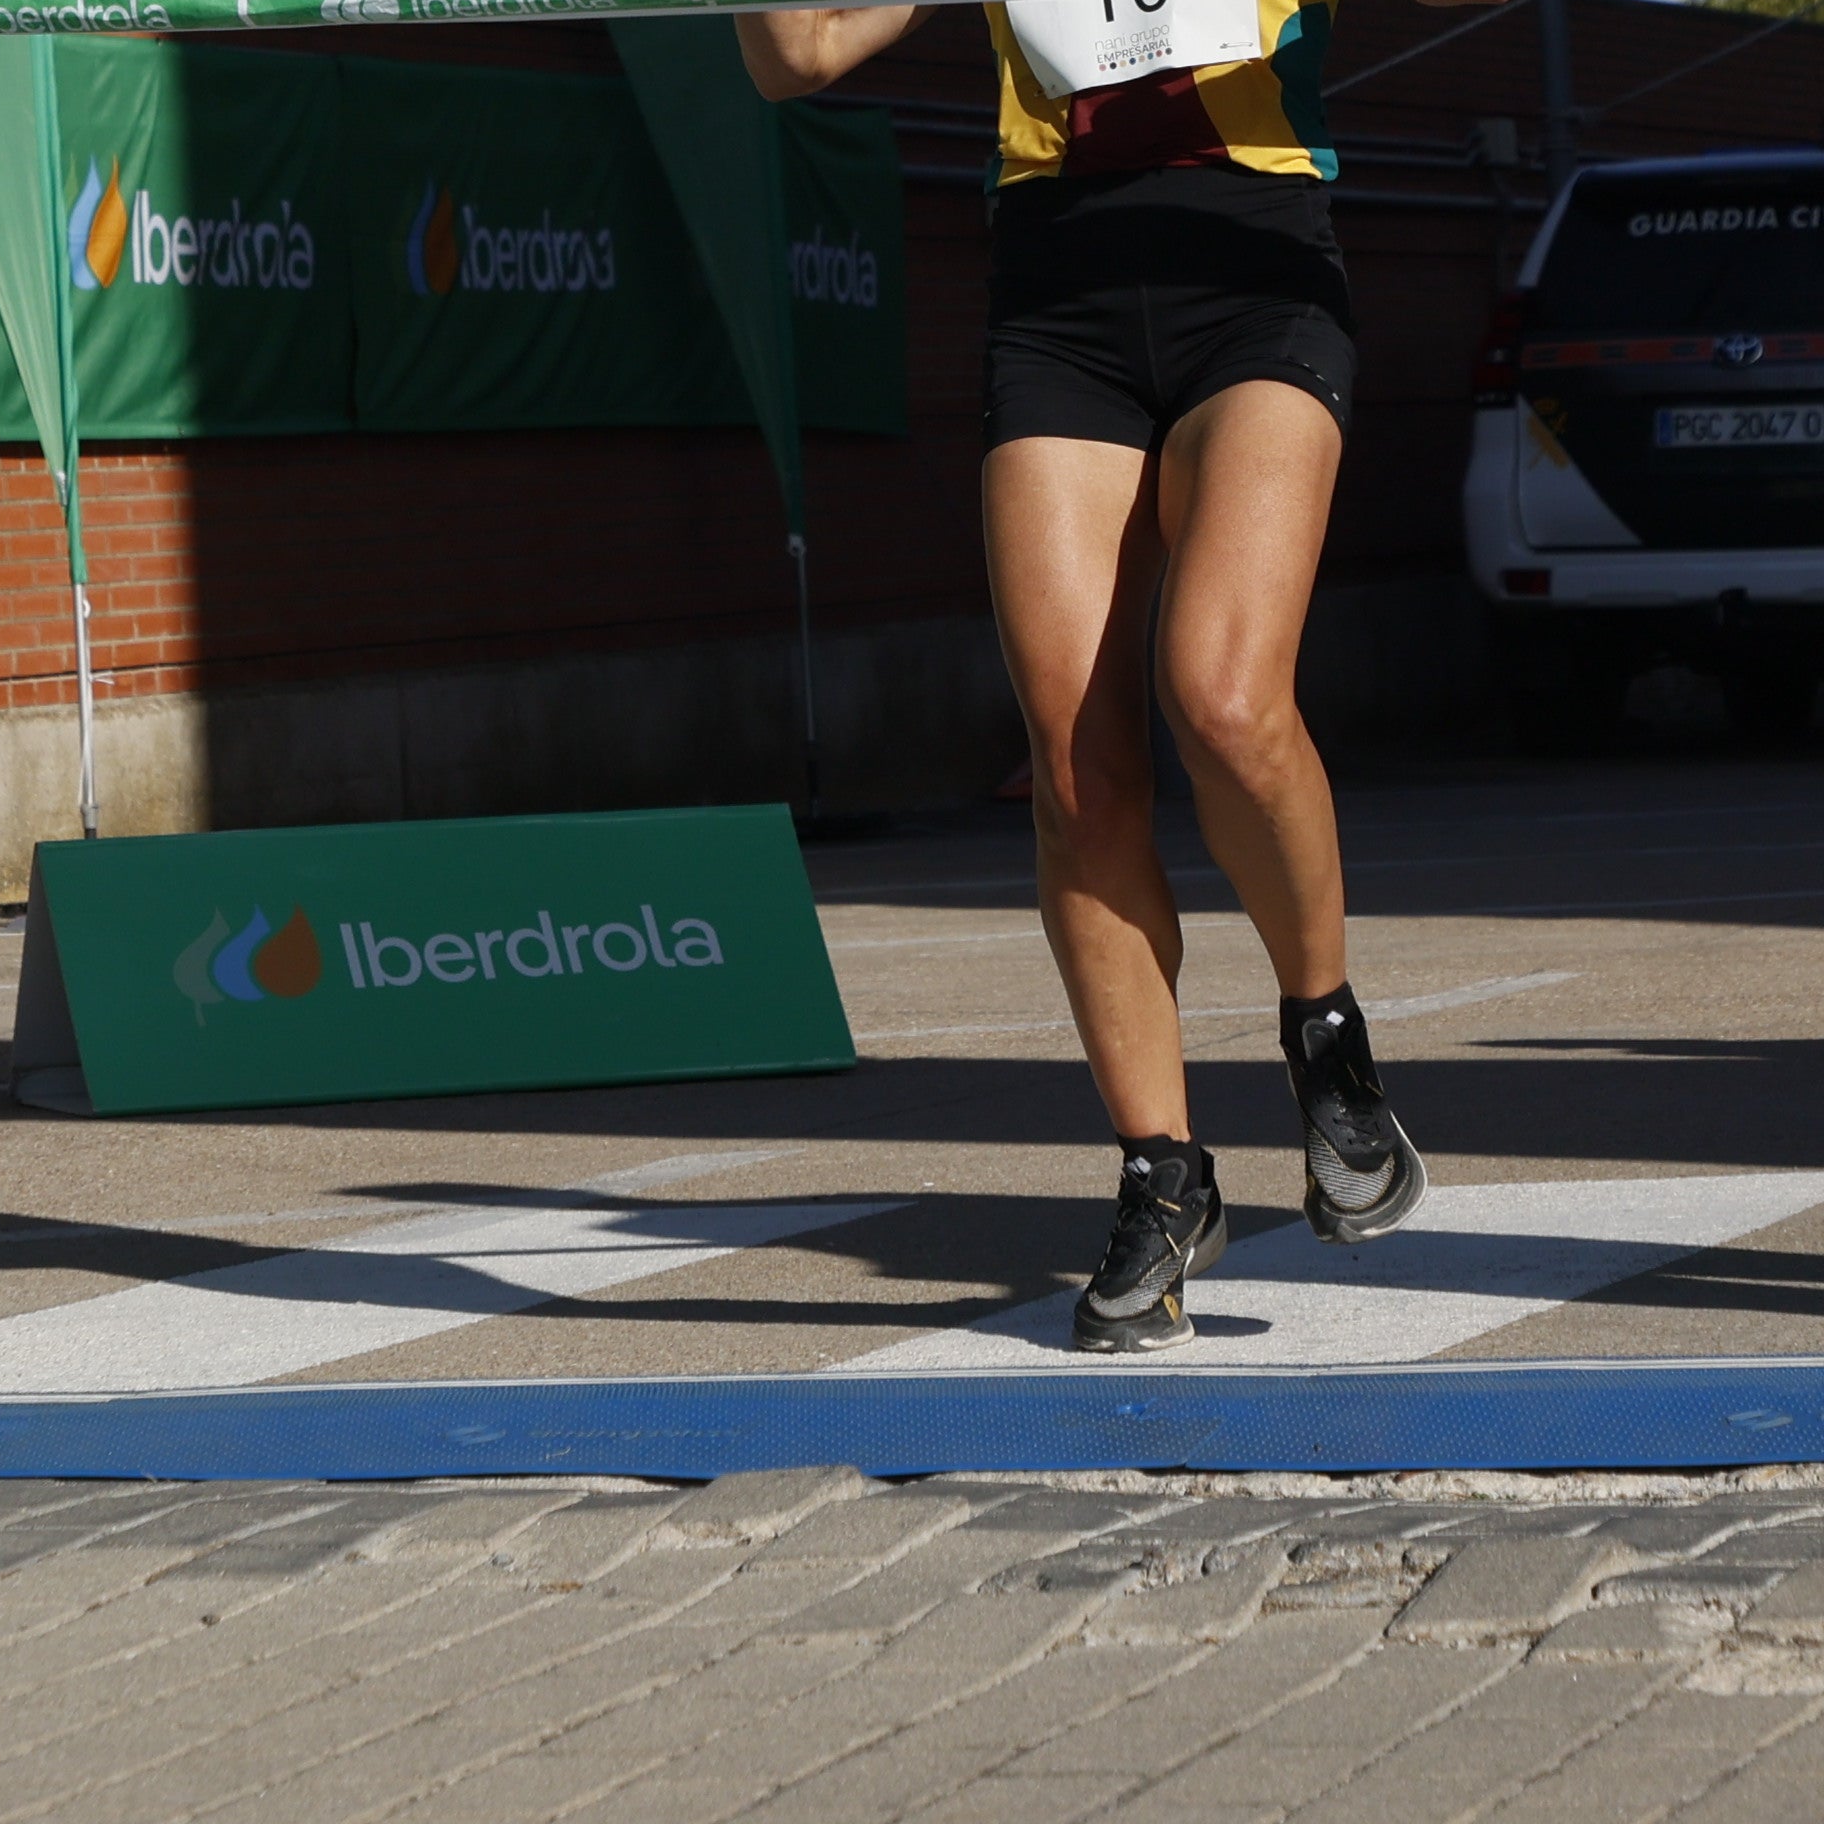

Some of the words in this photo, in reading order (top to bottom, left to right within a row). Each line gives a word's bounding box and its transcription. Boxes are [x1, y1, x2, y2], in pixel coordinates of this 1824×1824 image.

[1094, 36, 1127, 52] nani
[1129, 24, 1171, 48] grupo
[1097, 38, 1172, 64] EMPRESARIAL
[1628, 206, 1779, 237] GUARDIA
[131, 189, 314, 290] Iberdrola
[792, 223, 877, 308] rdrola
[1674, 414, 1723, 440] PGC
[1731, 412, 1797, 440] 2047
[339, 903, 725, 989] Iberdrola
